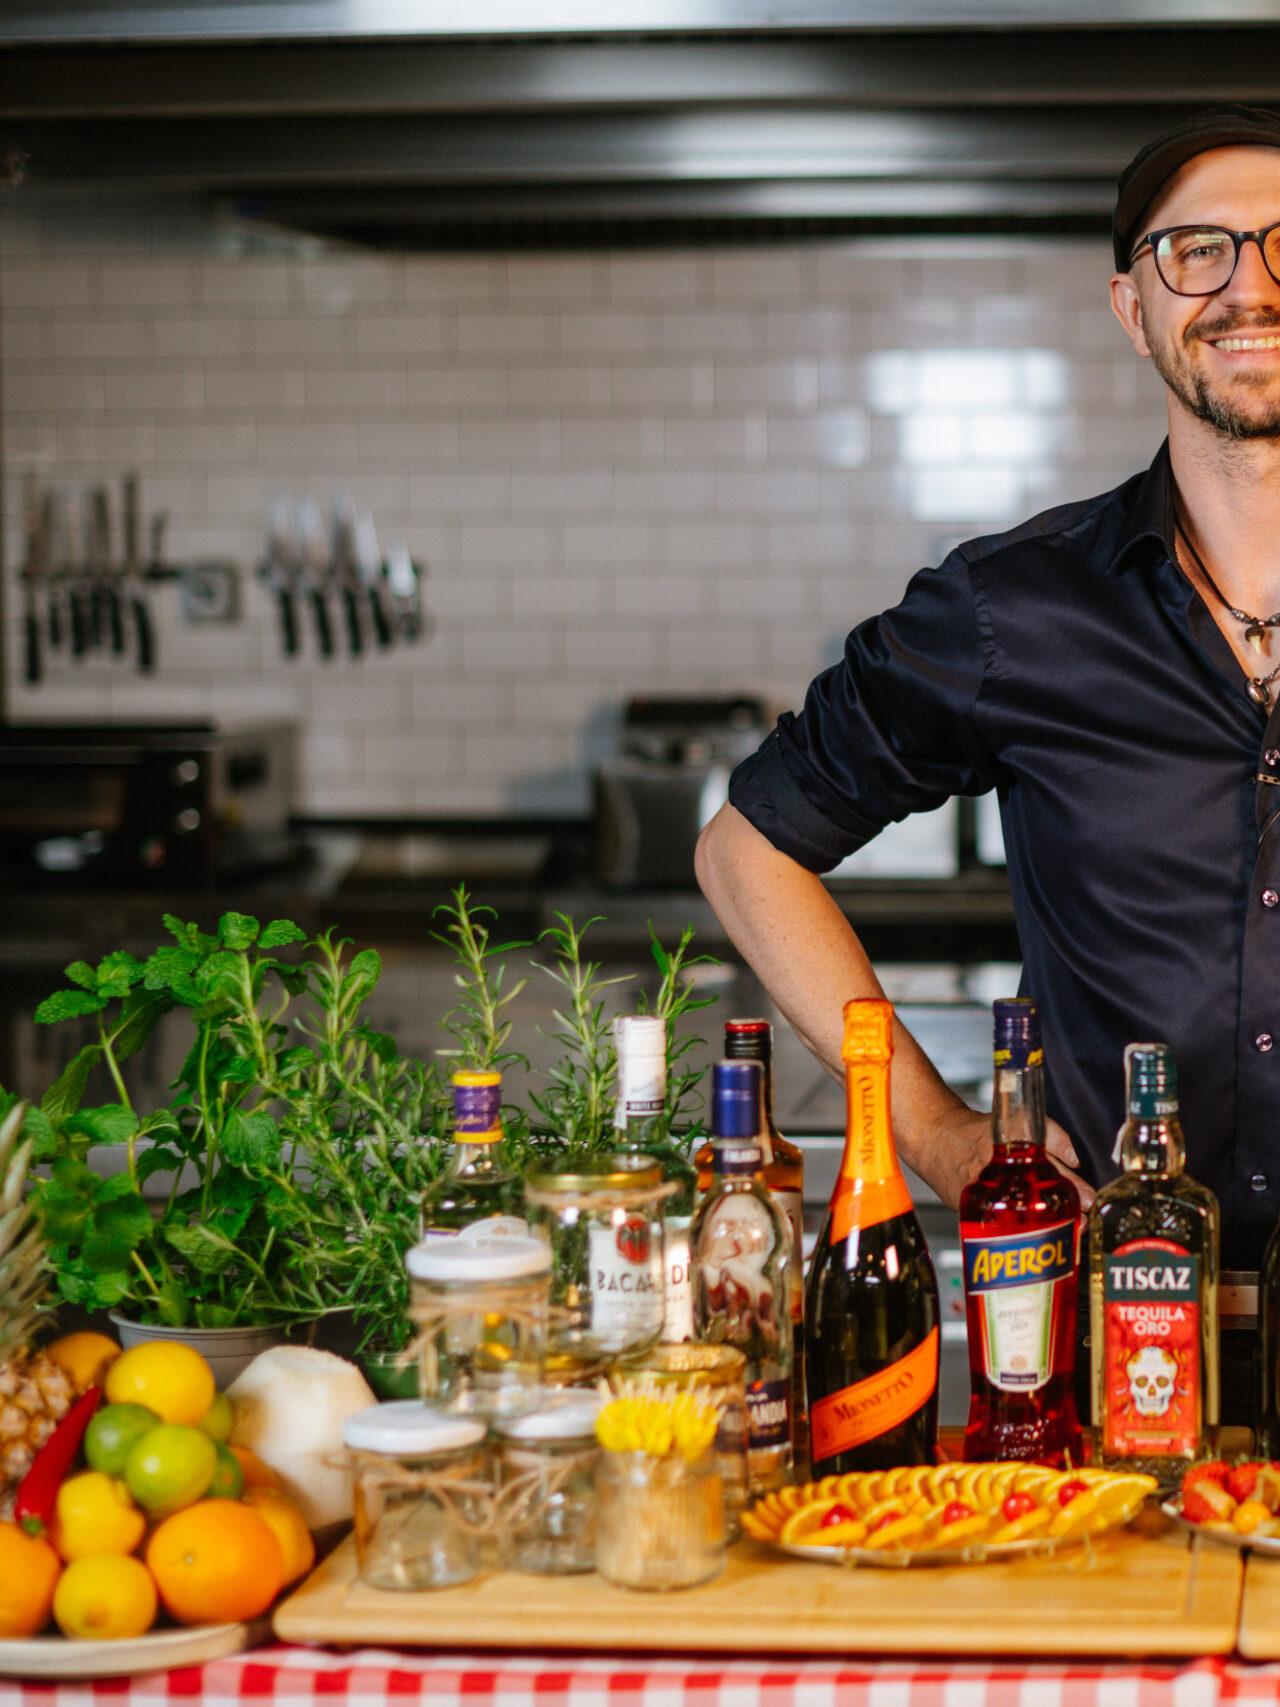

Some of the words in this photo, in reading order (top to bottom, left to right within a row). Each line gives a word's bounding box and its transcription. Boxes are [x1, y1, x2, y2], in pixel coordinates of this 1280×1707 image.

[973, 1240, 1067, 1284] APEROL
[1109, 1266, 1191, 1290] TISCAZ
[1118, 1305, 1186, 1321] TEQUILA
[1133, 1320, 1171, 1336] ORO
[833, 1371, 914, 1421] MIONETTO
